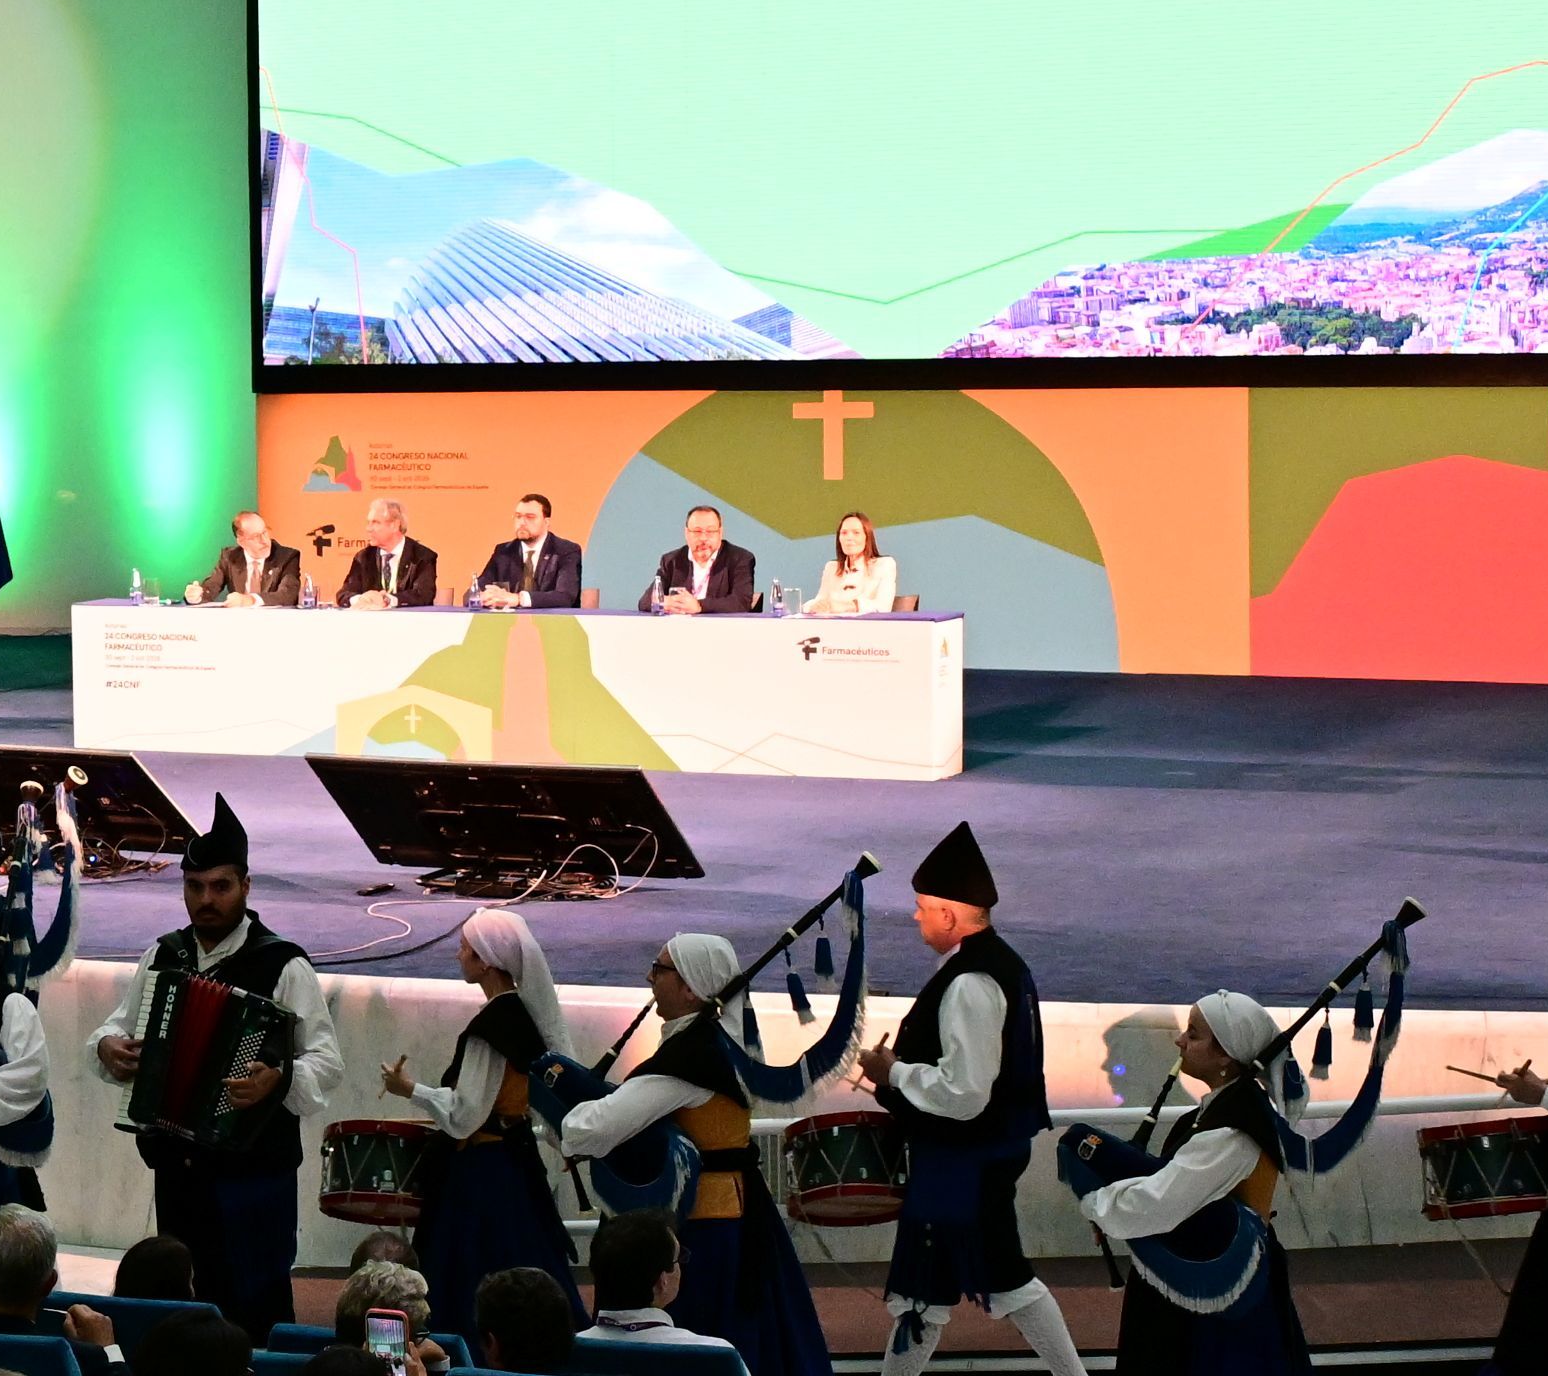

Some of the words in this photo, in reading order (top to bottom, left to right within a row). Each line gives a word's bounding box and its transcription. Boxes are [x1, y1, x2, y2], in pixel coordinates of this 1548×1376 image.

[380, 451, 425, 460] CONGRESO
[822, 646, 890, 656] Farmacéuticos
[158, 984, 177, 1039] HOHNER
